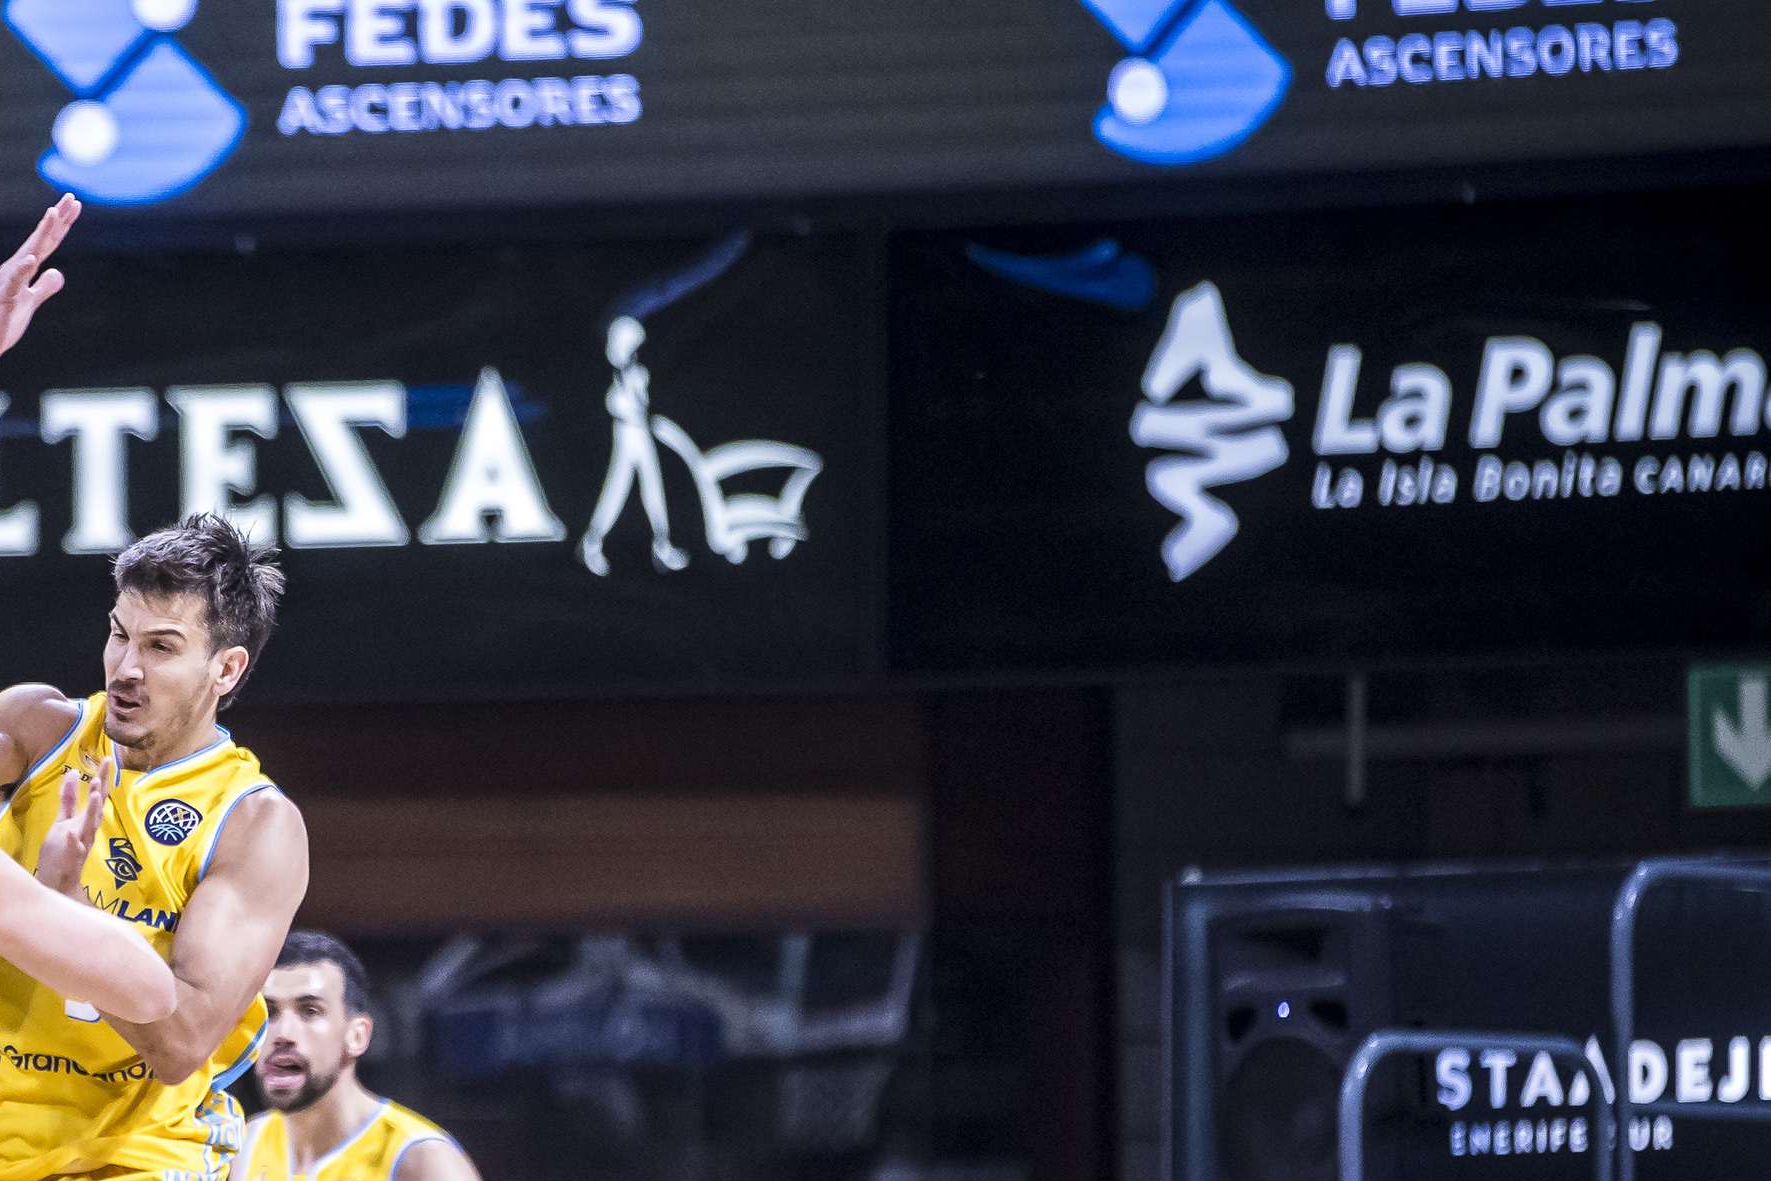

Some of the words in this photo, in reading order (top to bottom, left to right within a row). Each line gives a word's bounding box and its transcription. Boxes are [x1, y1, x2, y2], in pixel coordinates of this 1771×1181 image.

[276, 0, 644, 69] FEDES
[1326, 17, 1678, 88] ASCENSORES
[276, 73, 642, 136] ASCENSORES
[1310, 342, 1454, 456] La
[1468, 320, 1771, 449] Palm
[1311, 460, 1364, 510] La
[1377, 455, 1459, 507] Isla
[1472, 449, 1624, 503] Bonita
[1632, 450, 1771, 496] CANAR
